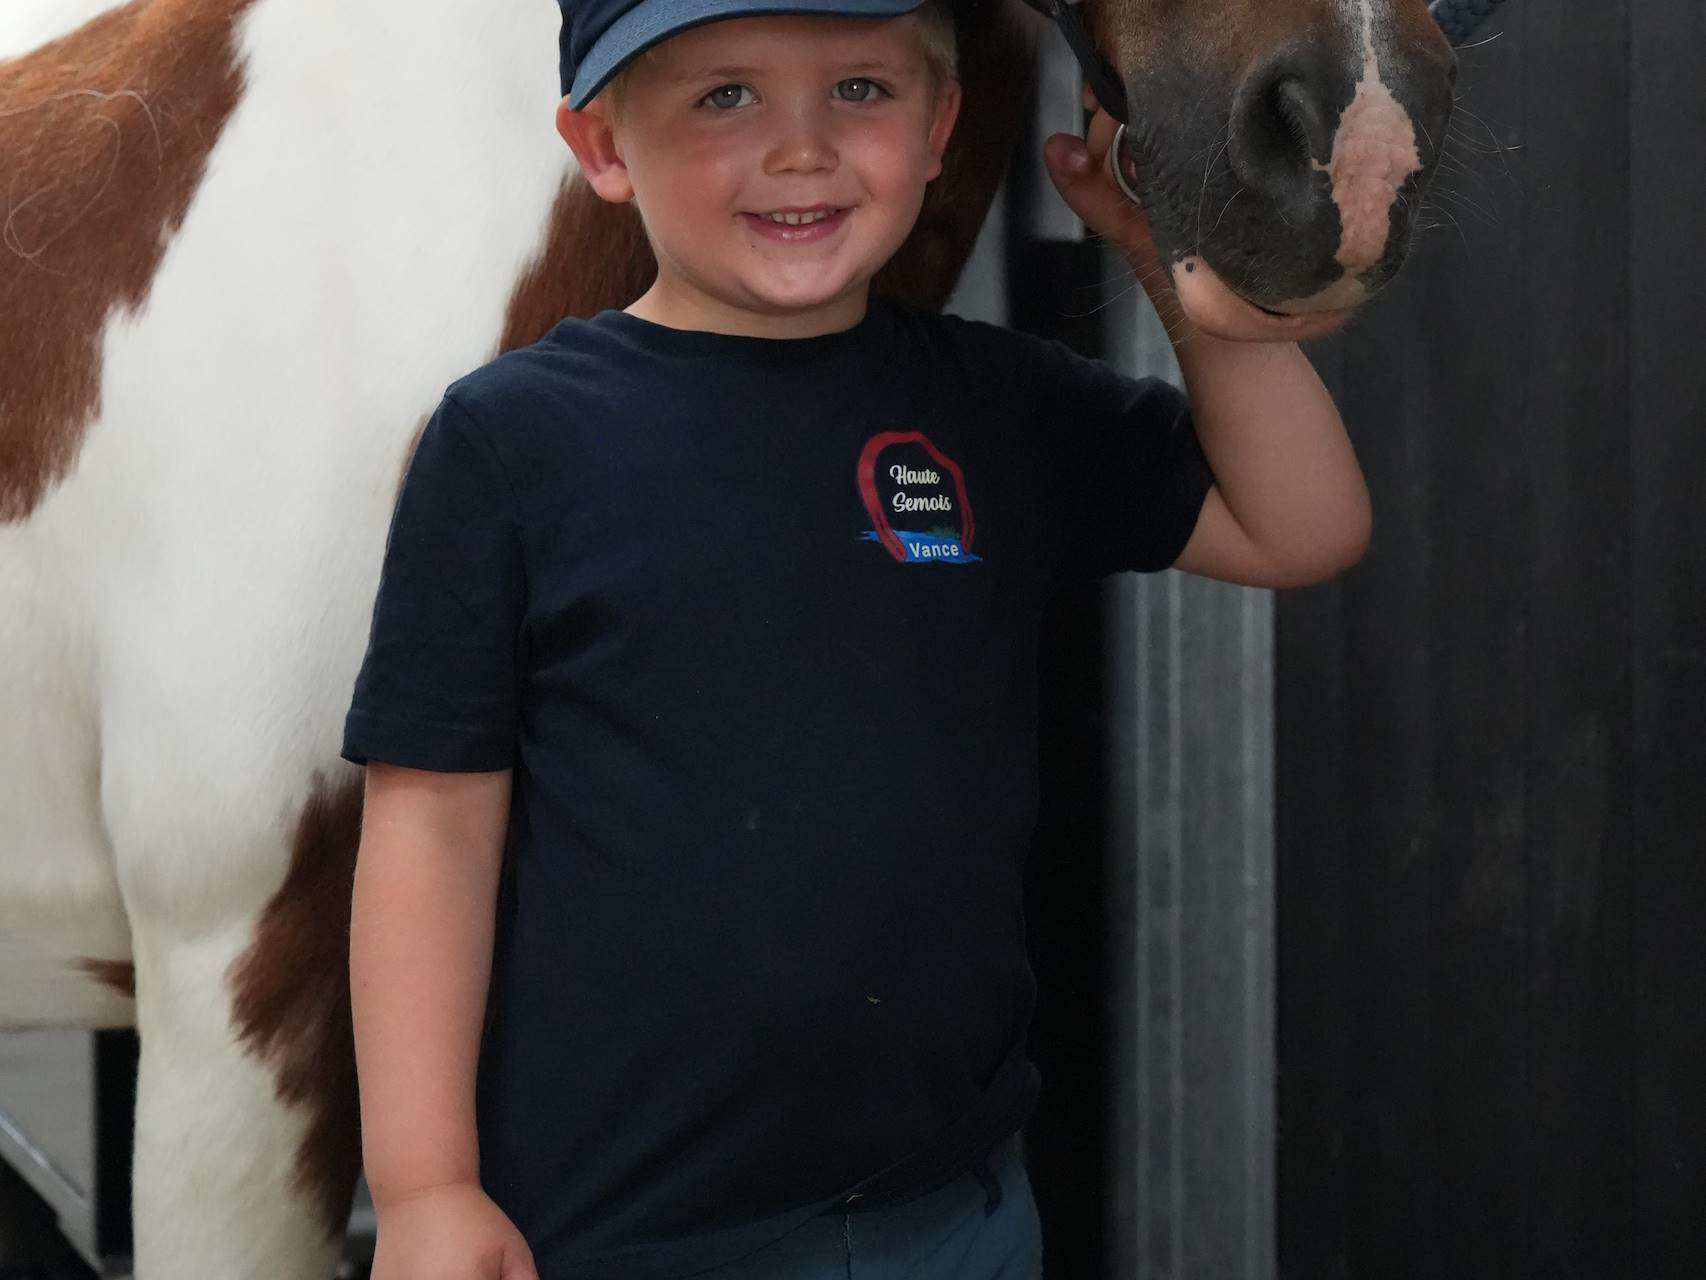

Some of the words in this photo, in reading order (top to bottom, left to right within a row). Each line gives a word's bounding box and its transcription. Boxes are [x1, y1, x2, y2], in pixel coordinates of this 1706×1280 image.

[890, 464, 940, 485] Haute
[892, 492, 952, 512] Semois
[910, 543, 958, 558] Vance
